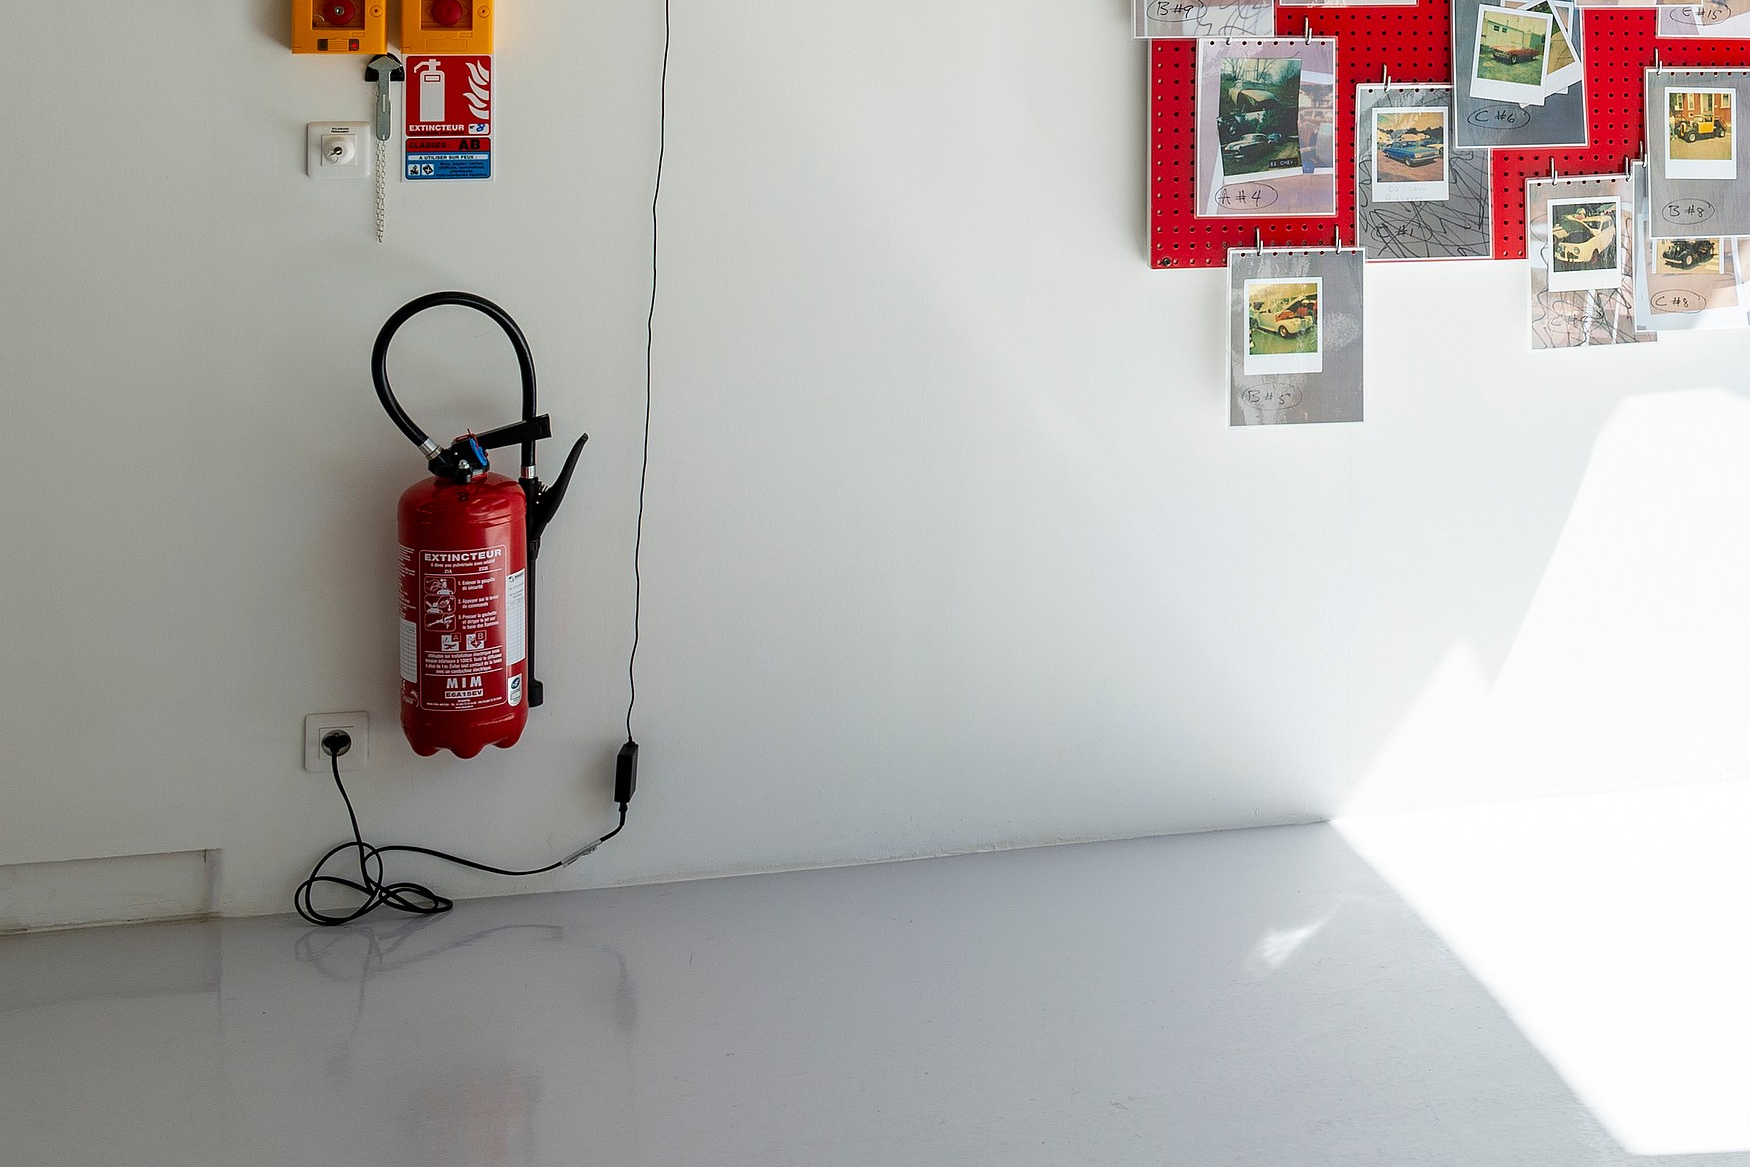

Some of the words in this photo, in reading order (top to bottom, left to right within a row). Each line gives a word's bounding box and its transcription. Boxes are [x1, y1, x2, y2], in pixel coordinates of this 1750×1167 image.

[408, 124, 465, 132] EXTINCTEUR
[459, 138, 481, 151] AB
[424, 548, 502, 562] EXTINCTEUR
[446, 675, 482, 689] MIM
